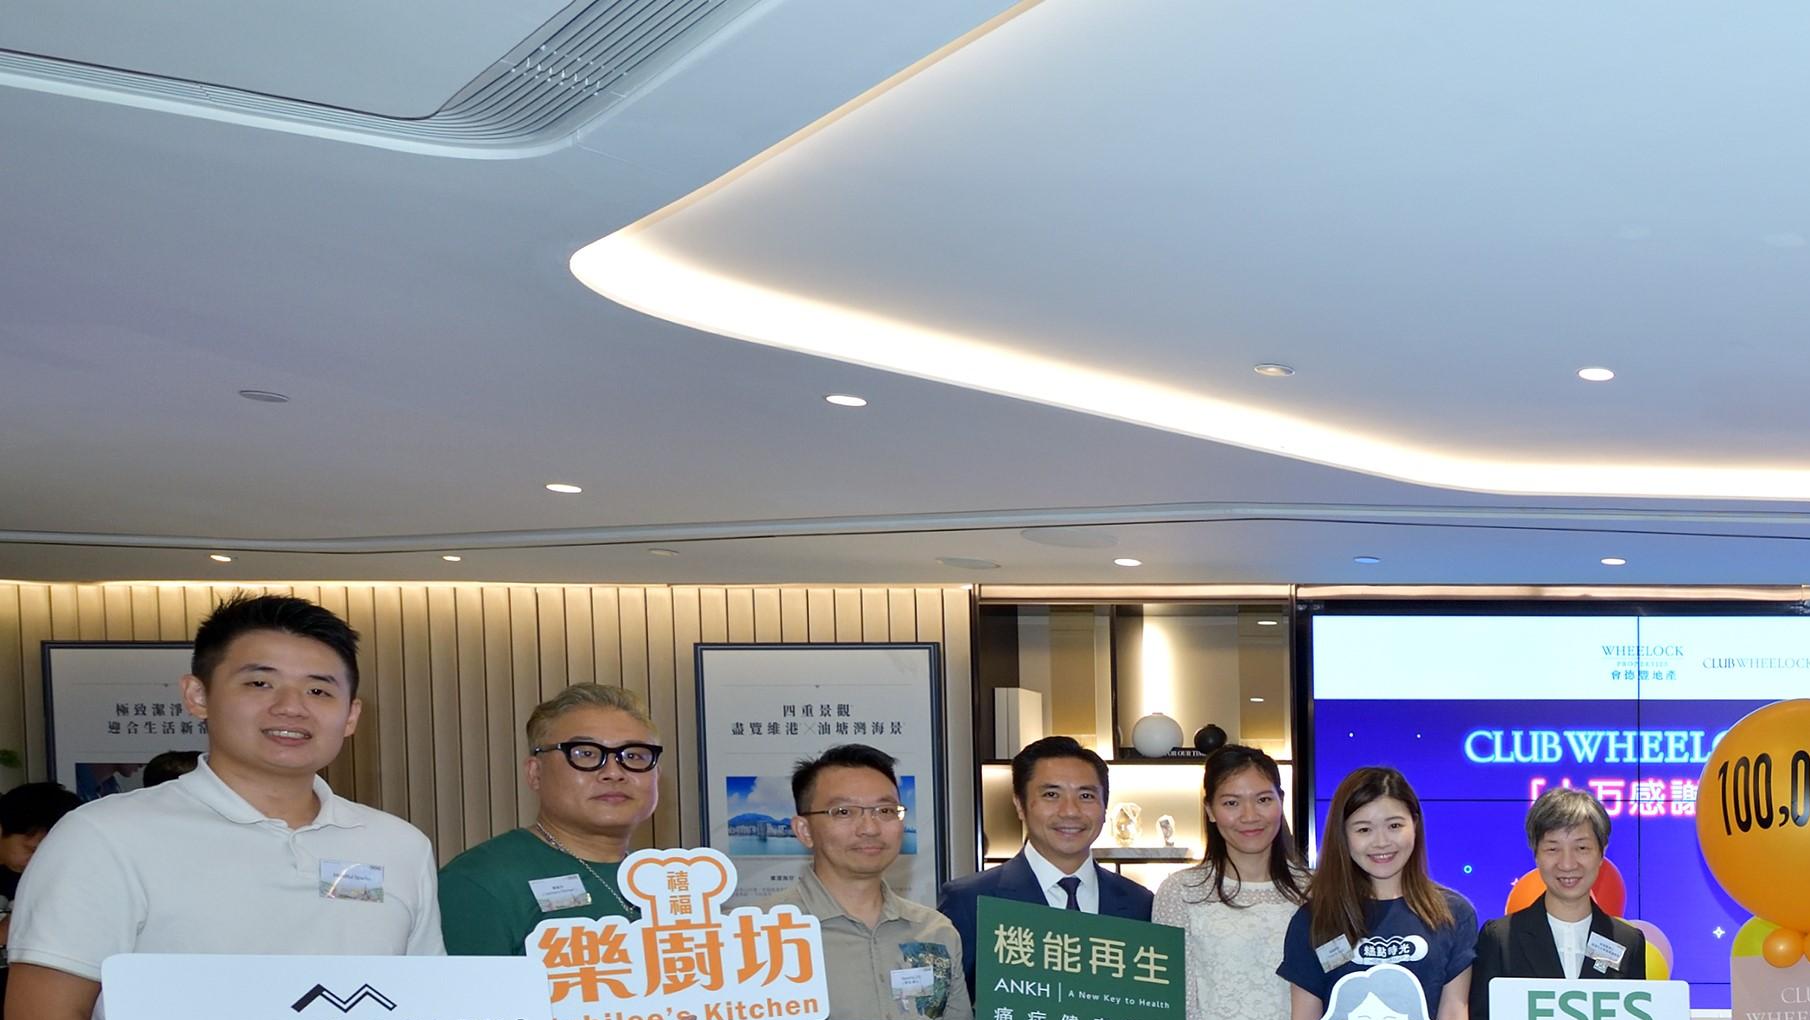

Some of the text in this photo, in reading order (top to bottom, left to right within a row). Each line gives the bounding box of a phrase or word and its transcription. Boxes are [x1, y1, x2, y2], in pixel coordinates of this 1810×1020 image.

[1601, 645, 1684, 657] WHEELOCK
[783, 703, 851, 718] 四重景觀
[667, 870, 694, 916] 禧福
[538, 912, 815, 1004] 樂廚坊
[993, 923, 1170, 985] 機能再生
[994, 977, 1170, 1009] ANKH A New Key to Health
